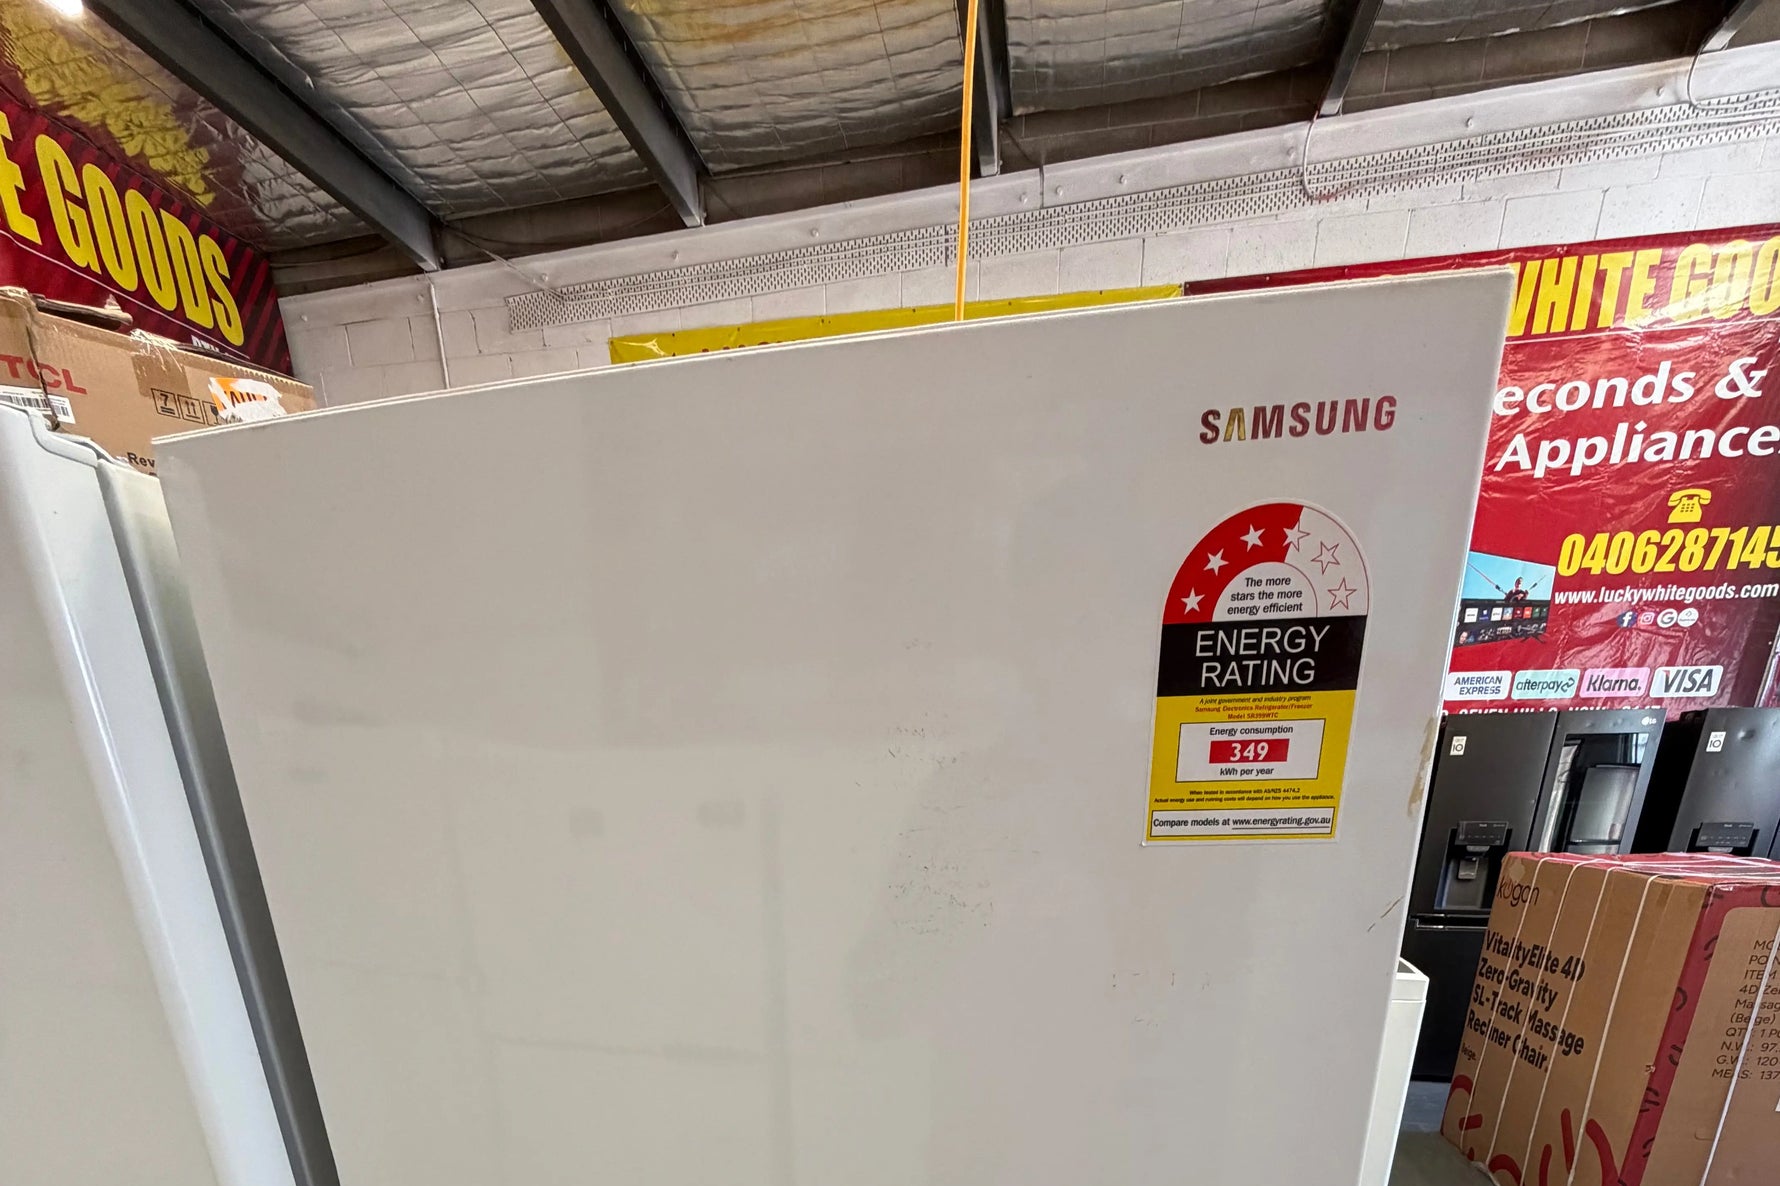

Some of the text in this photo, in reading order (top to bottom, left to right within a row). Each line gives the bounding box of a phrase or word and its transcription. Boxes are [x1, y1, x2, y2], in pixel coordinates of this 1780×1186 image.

[35, 134, 244, 346] GOODS
[0, 354, 87, 395] TCL
[1493, 357, 1768, 416] econds &
[1199, 395, 1397, 444] SAMSUNG
[1494, 421, 1780, 478] Appliance
[1557, 526, 1780, 577] 0406287145
[1245, 577, 1291, 587] The more
[1231, 590, 1303, 601] stars the more
[1554, 583, 1779, 605] www.luckywhitegoods.com
[1227, 602, 1303, 616] energy efficient
[1195, 625, 1330, 657] ENERGY
[1200, 657, 1315, 688] RATING
[1454, 676, 1502, 686] AMERICAN
[1662, 668, 1714, 693] VISA
[1459, 686, 1501, 695] EXPRESS
[1516, 678, 1562, 694] afterpay
[1209, 725, 1293, 737] Energy consumption
[1230, 742, 1269, 762] 349
[1220, 767, 1274, 777] kWh per year
[1153, 816, 1331, 828] Compare models at www.energyrating.gov.au
[1561, 955, 1586, 982] 4D
[1731, 1012, 1775, 1026] (Bege)
[1523, 1009, 1584, 1056] Massage
[1711, 1069, 1752, 1079] MES:
